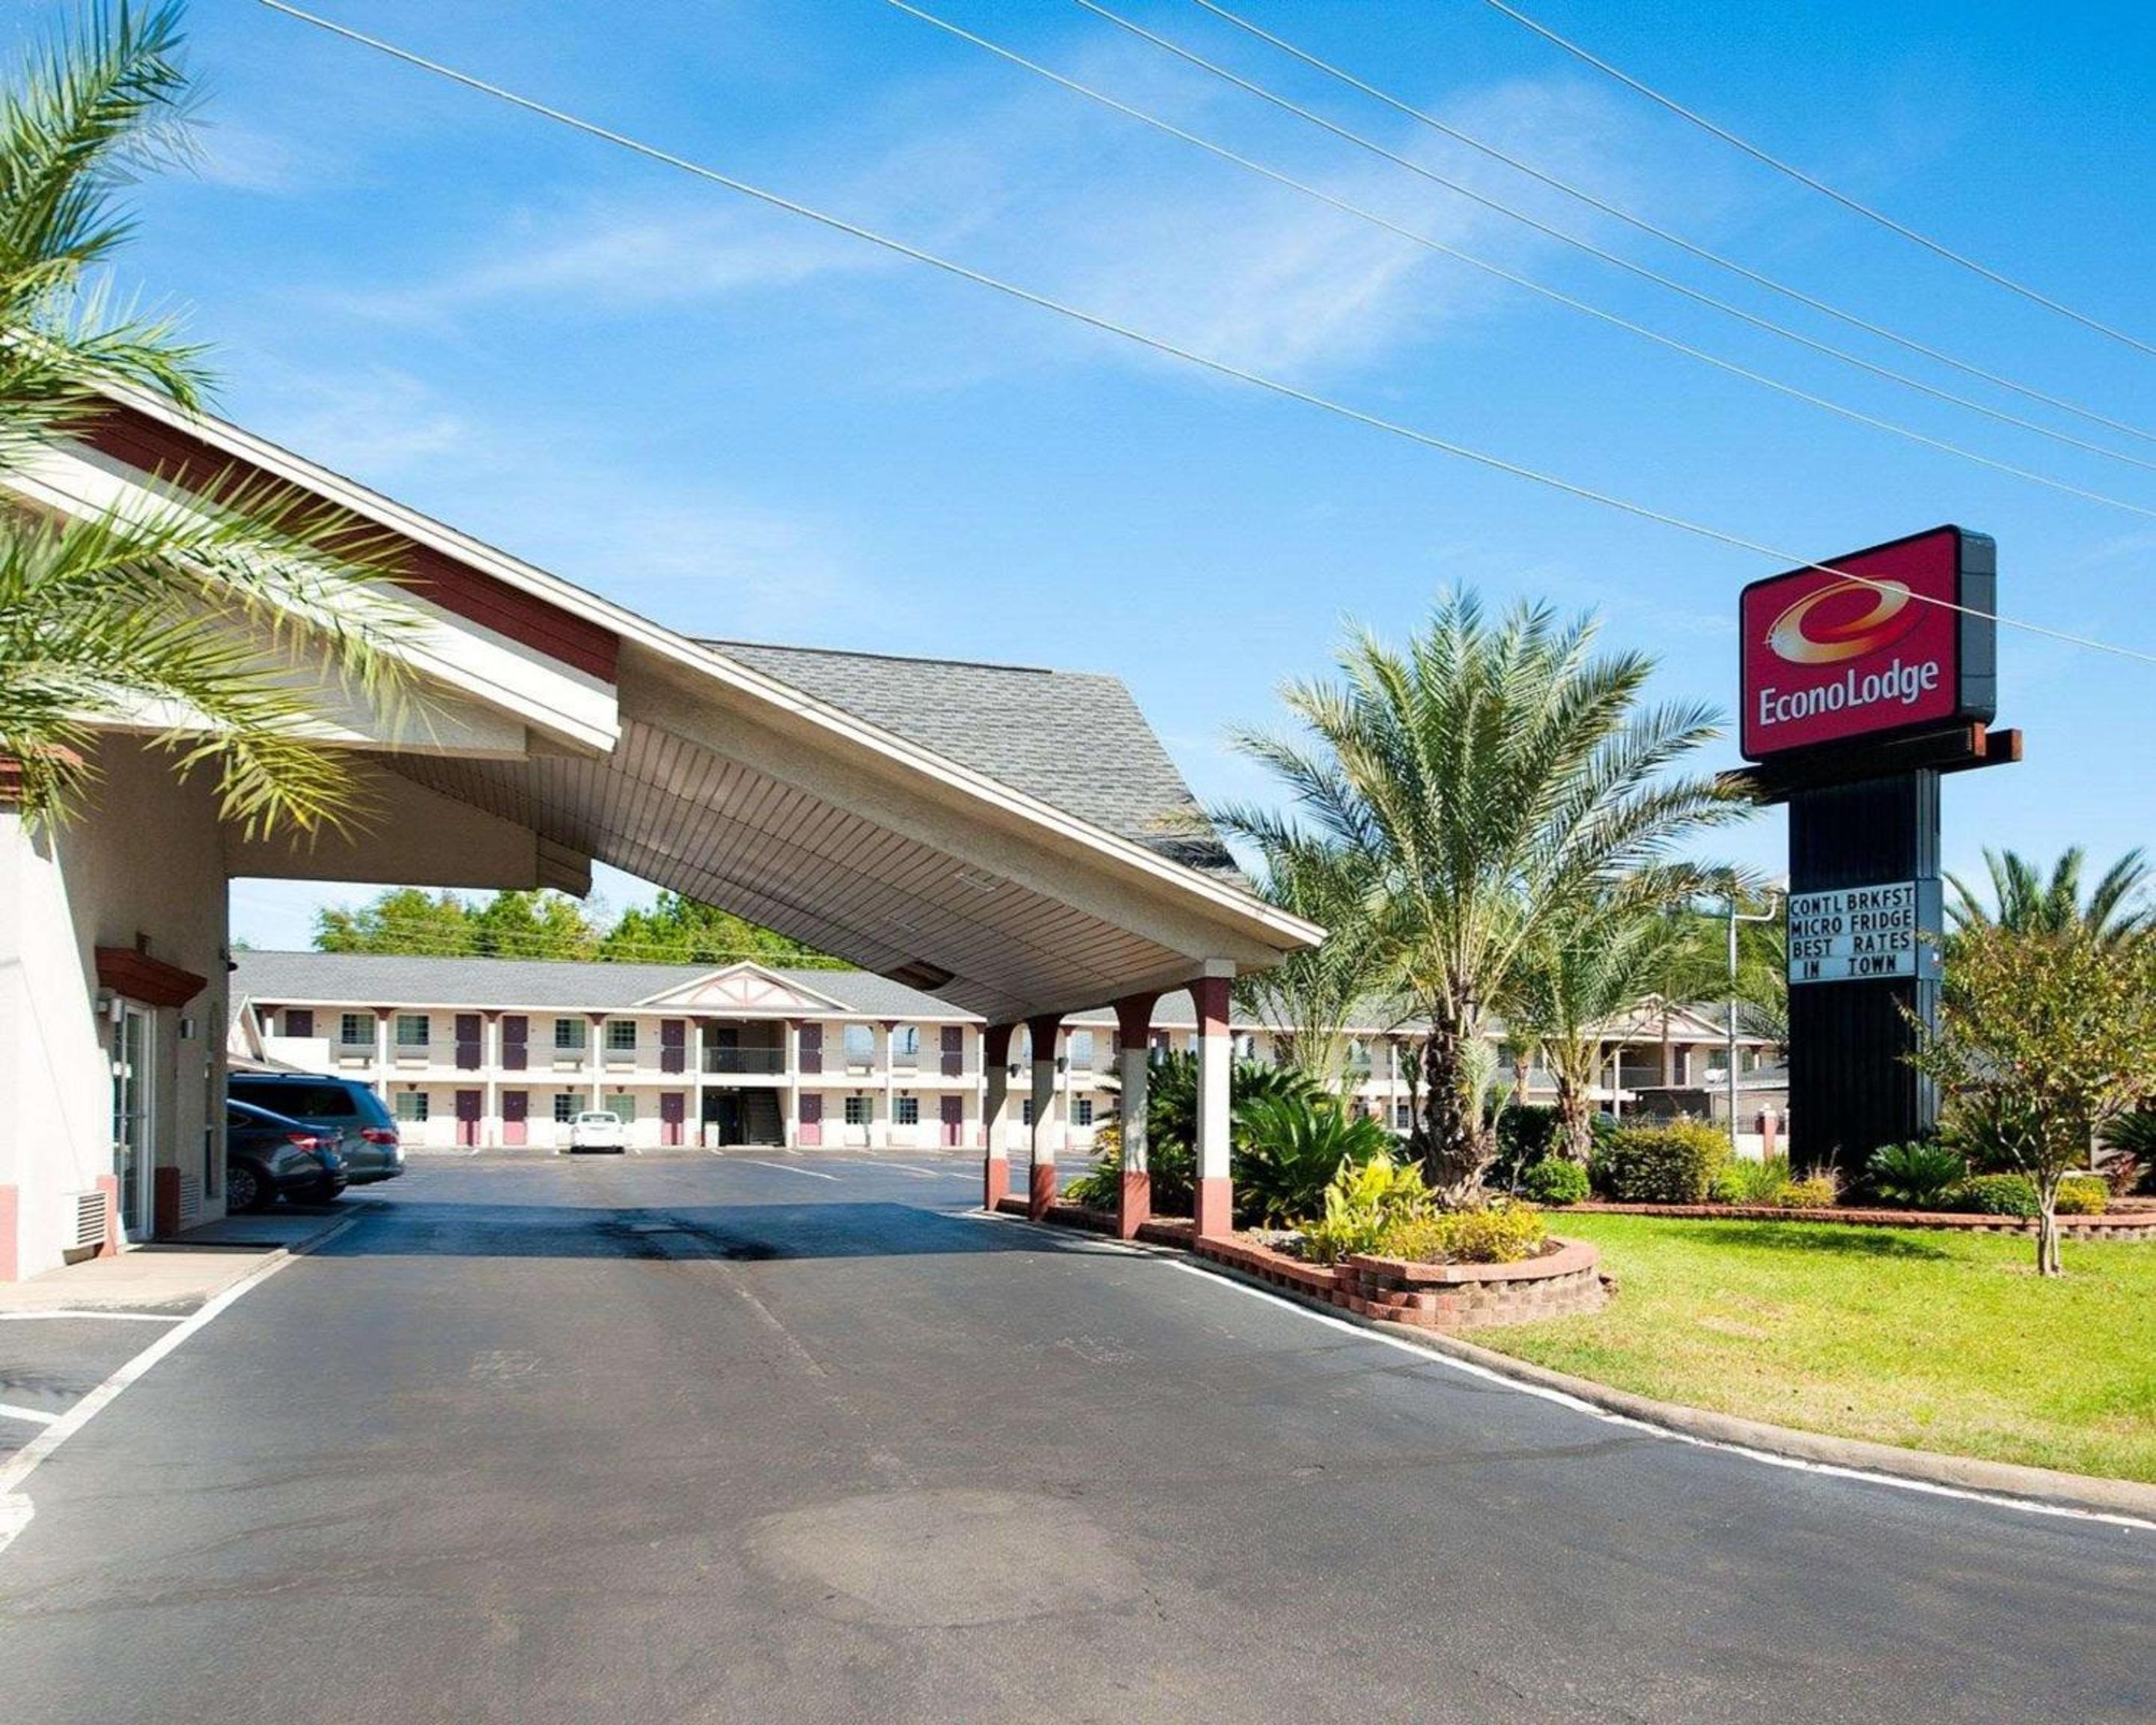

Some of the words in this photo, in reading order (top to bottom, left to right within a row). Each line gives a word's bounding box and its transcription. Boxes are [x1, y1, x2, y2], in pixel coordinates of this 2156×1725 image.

[1759, 658, 1939, 725] EconoLodge
[1791, 896, 1842, 916] CONTL
[1847, 888, 1913, 910] BRKFST
[1791, 917, 1842, 937] MICRO
[1851, 910, 1911, 933] FRIDGE
[1793, 939, 1833, 958] BEST
[1854, 931, 1910, 953] RATES
[1803, 961, 1820, 979] IN
[1848, 955, 1896, 976] TOWN
